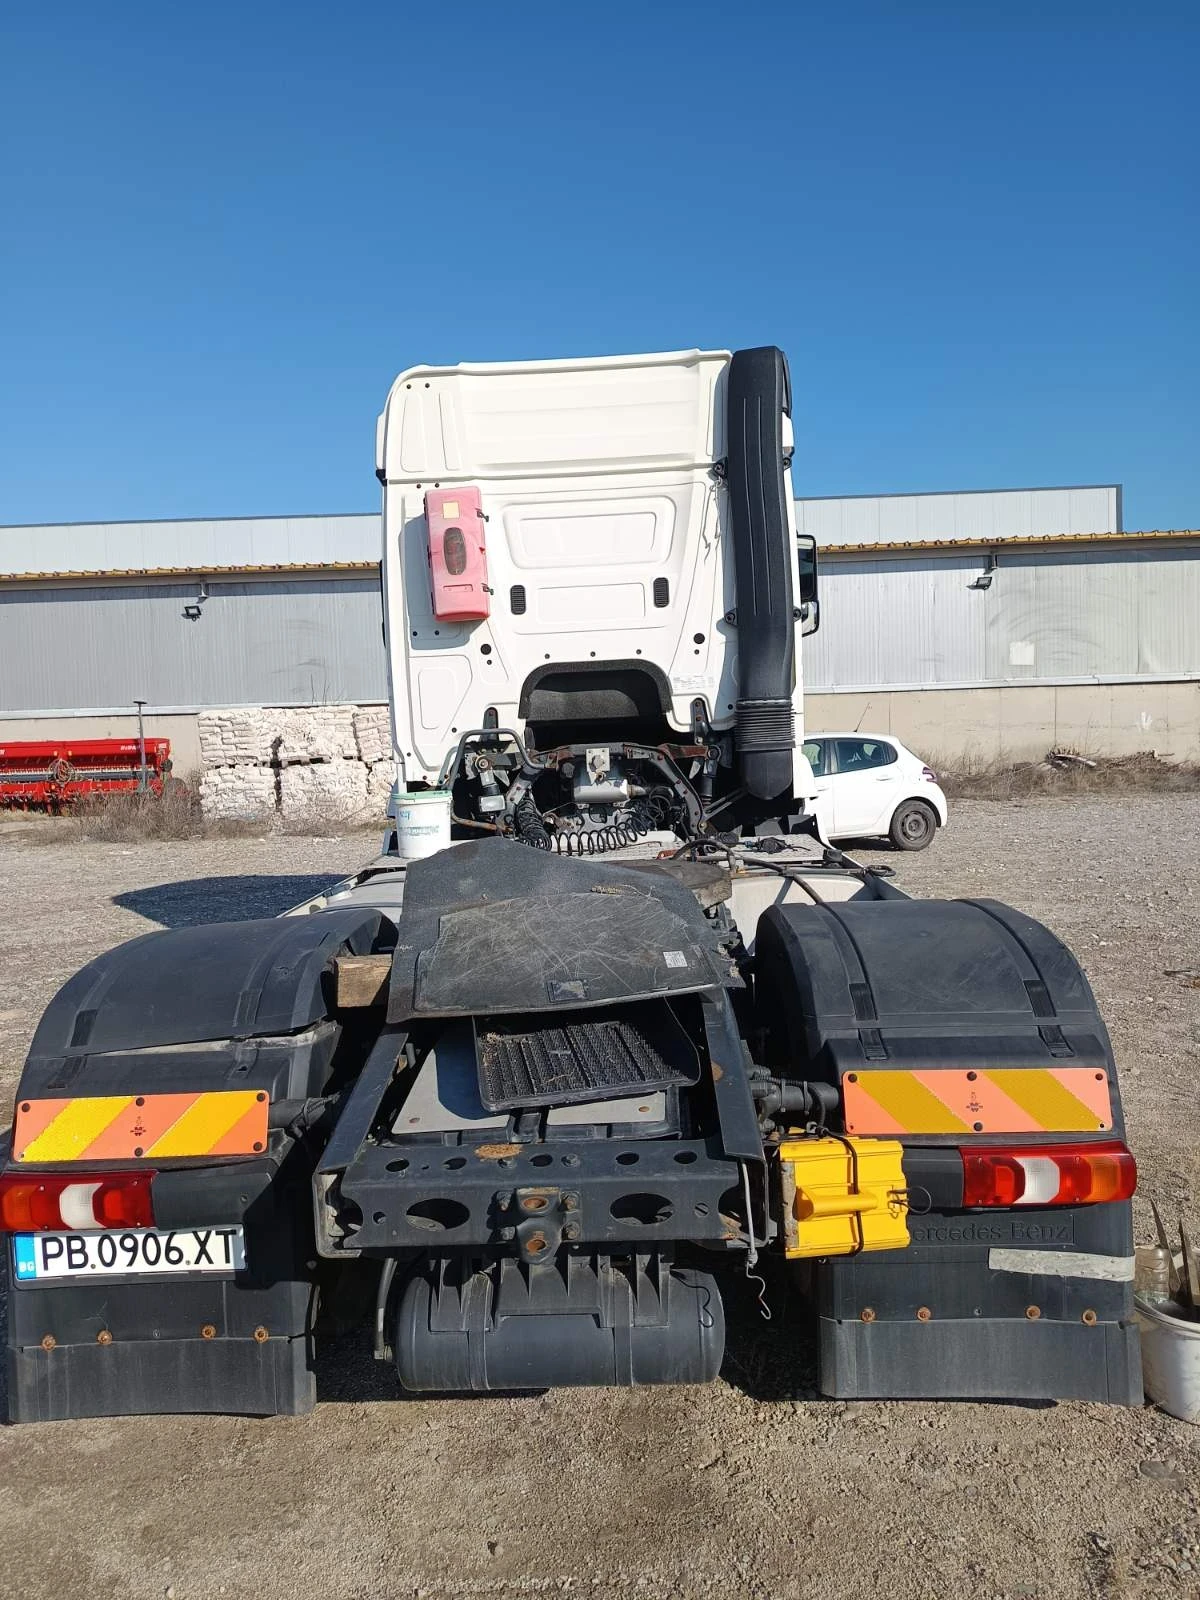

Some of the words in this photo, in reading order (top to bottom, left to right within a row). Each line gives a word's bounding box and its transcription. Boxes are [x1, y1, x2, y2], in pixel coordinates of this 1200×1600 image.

[911, 1220, 1068, 1241] ercedes-Benz
[41, 1230, 236, 1271] PB.0906.XT
[18, 1261, 35, 1273] BG
